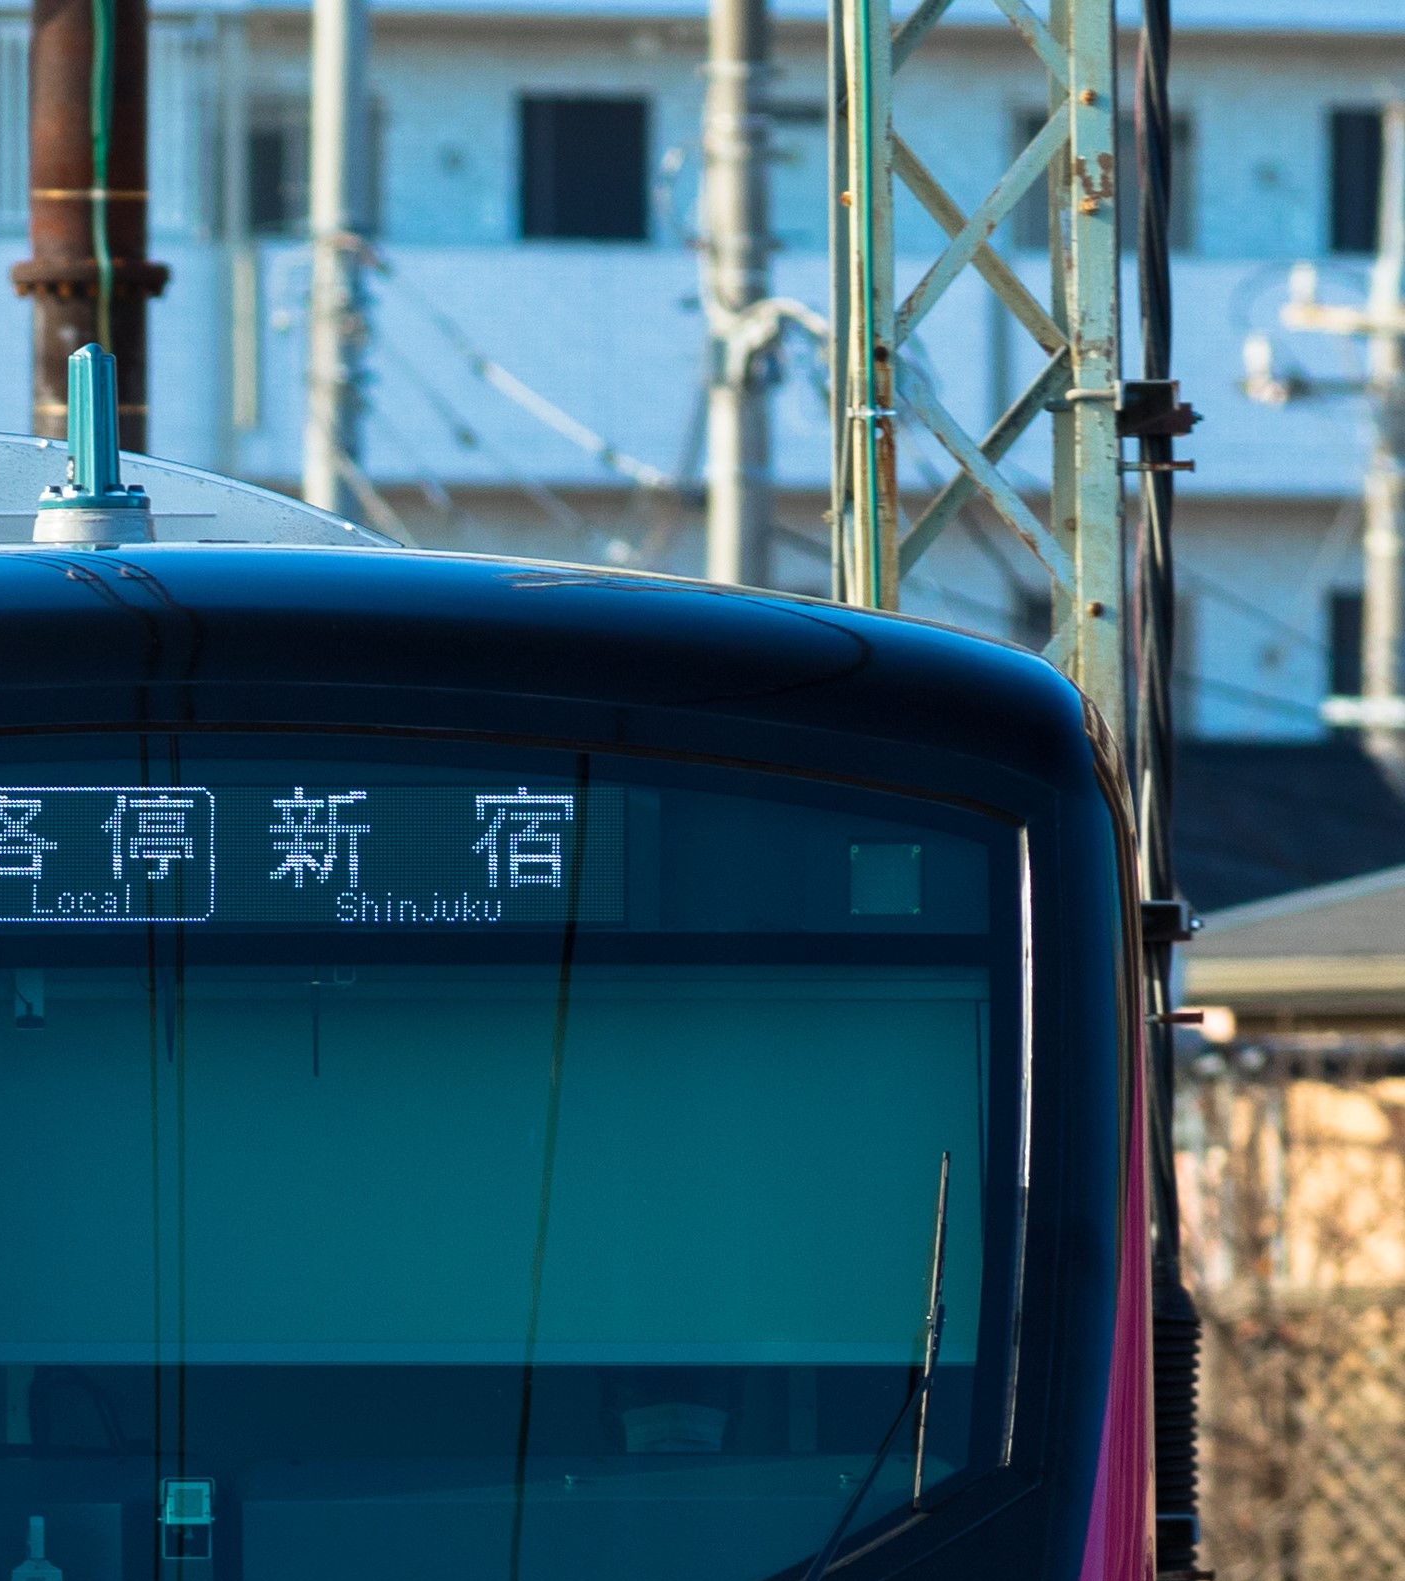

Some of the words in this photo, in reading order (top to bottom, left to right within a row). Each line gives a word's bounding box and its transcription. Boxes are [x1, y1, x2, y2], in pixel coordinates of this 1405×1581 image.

[269, 786, 574, 888] 新宿
[32, 884, 130, 914] Local
[336, 892, 502, 922] Shinjuku
